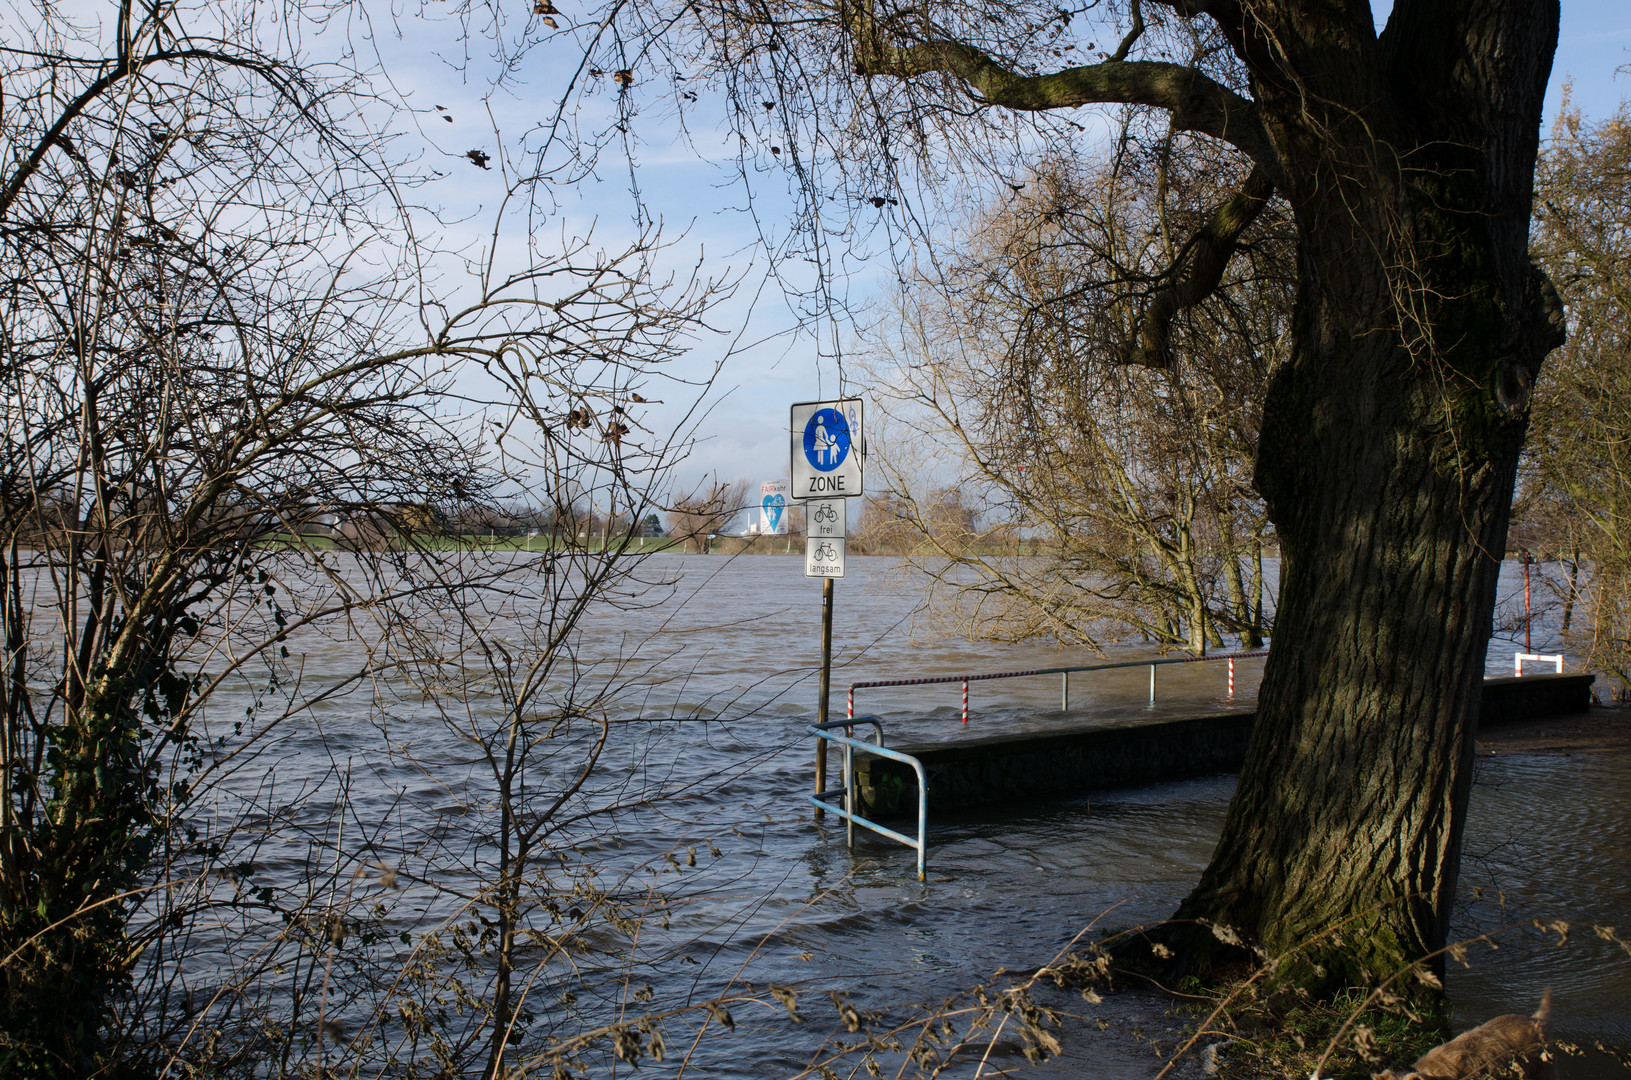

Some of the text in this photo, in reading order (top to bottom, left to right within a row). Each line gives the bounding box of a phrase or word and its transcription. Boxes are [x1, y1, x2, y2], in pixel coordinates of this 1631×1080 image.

[809, 476, 845, 492] ZONE
[820, 525, 833, 534] frei
[810, 564, 841, 574] langsam
